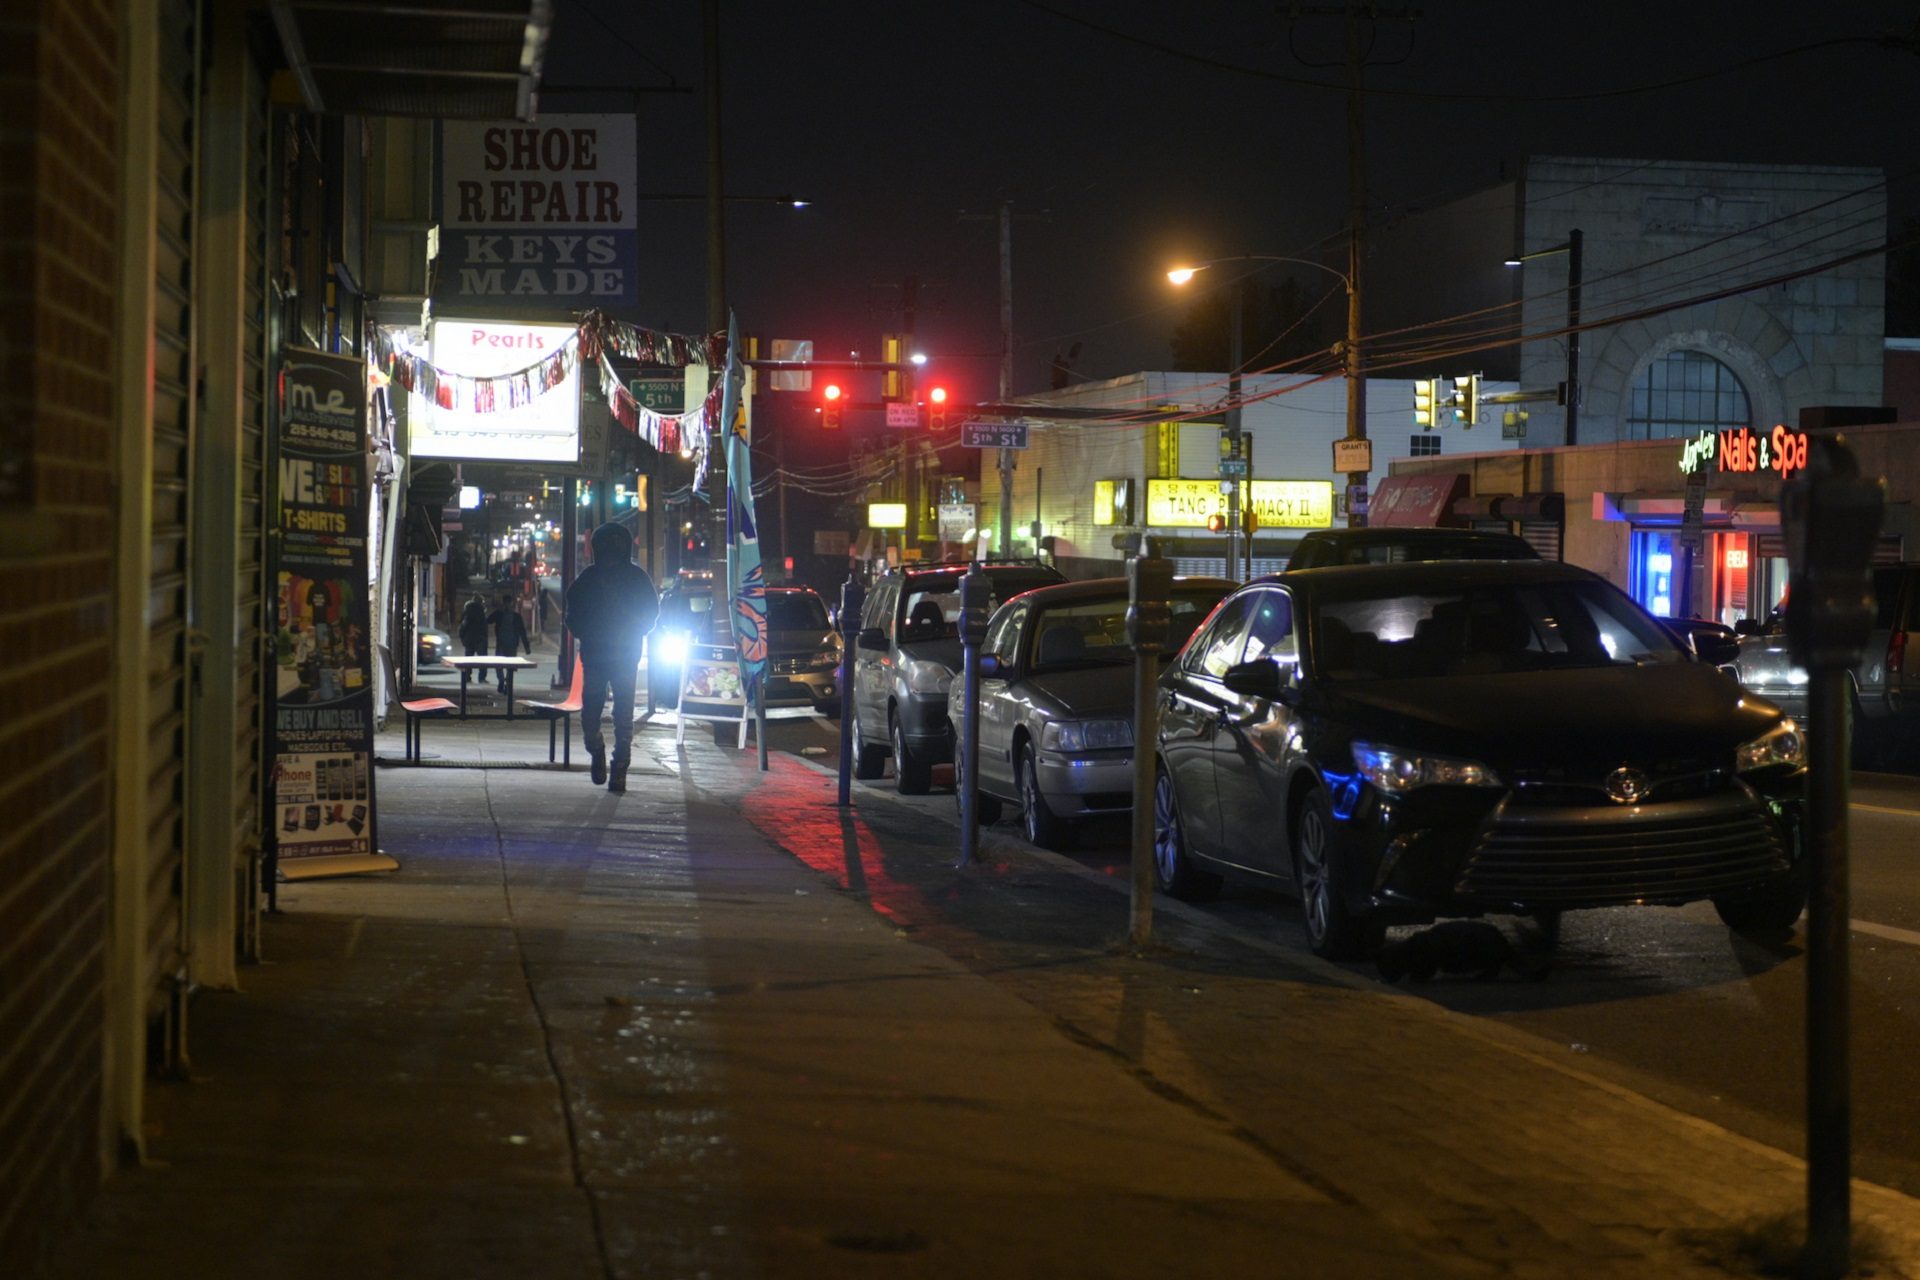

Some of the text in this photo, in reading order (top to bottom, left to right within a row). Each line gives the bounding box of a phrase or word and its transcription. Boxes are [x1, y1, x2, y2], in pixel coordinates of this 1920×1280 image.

[484, 128, 597, 171] SHOE
[457, 181, 622, 223] REPAIR
[464, 235, 617, 265] KEYS
[458, 268, 624, 296] MADE
[471, 329, 545, 350] Pearls
[647, 383, 669, 392] 5500
[670, 382, 680, 393] N
[645, 392, 673, 408] 5th
[971, 432, 1018, 446] 5th St
[991, 425, 998, 433] N
[1341, 442, 1368, 450] GRANT'S
[1718, 426, 1757, 473] Nails
[1759, 436, 1770, 470] &
[1771, 424, 1808, 479] Spa
[1168, 497, 1207, 515] TANG
[283, 508, 347, 533] T-SHIRTS
[292, 708, 315, 729] BUY
[316, 708, 340, 729] AND
[340, 708, 365, 729] SELL
